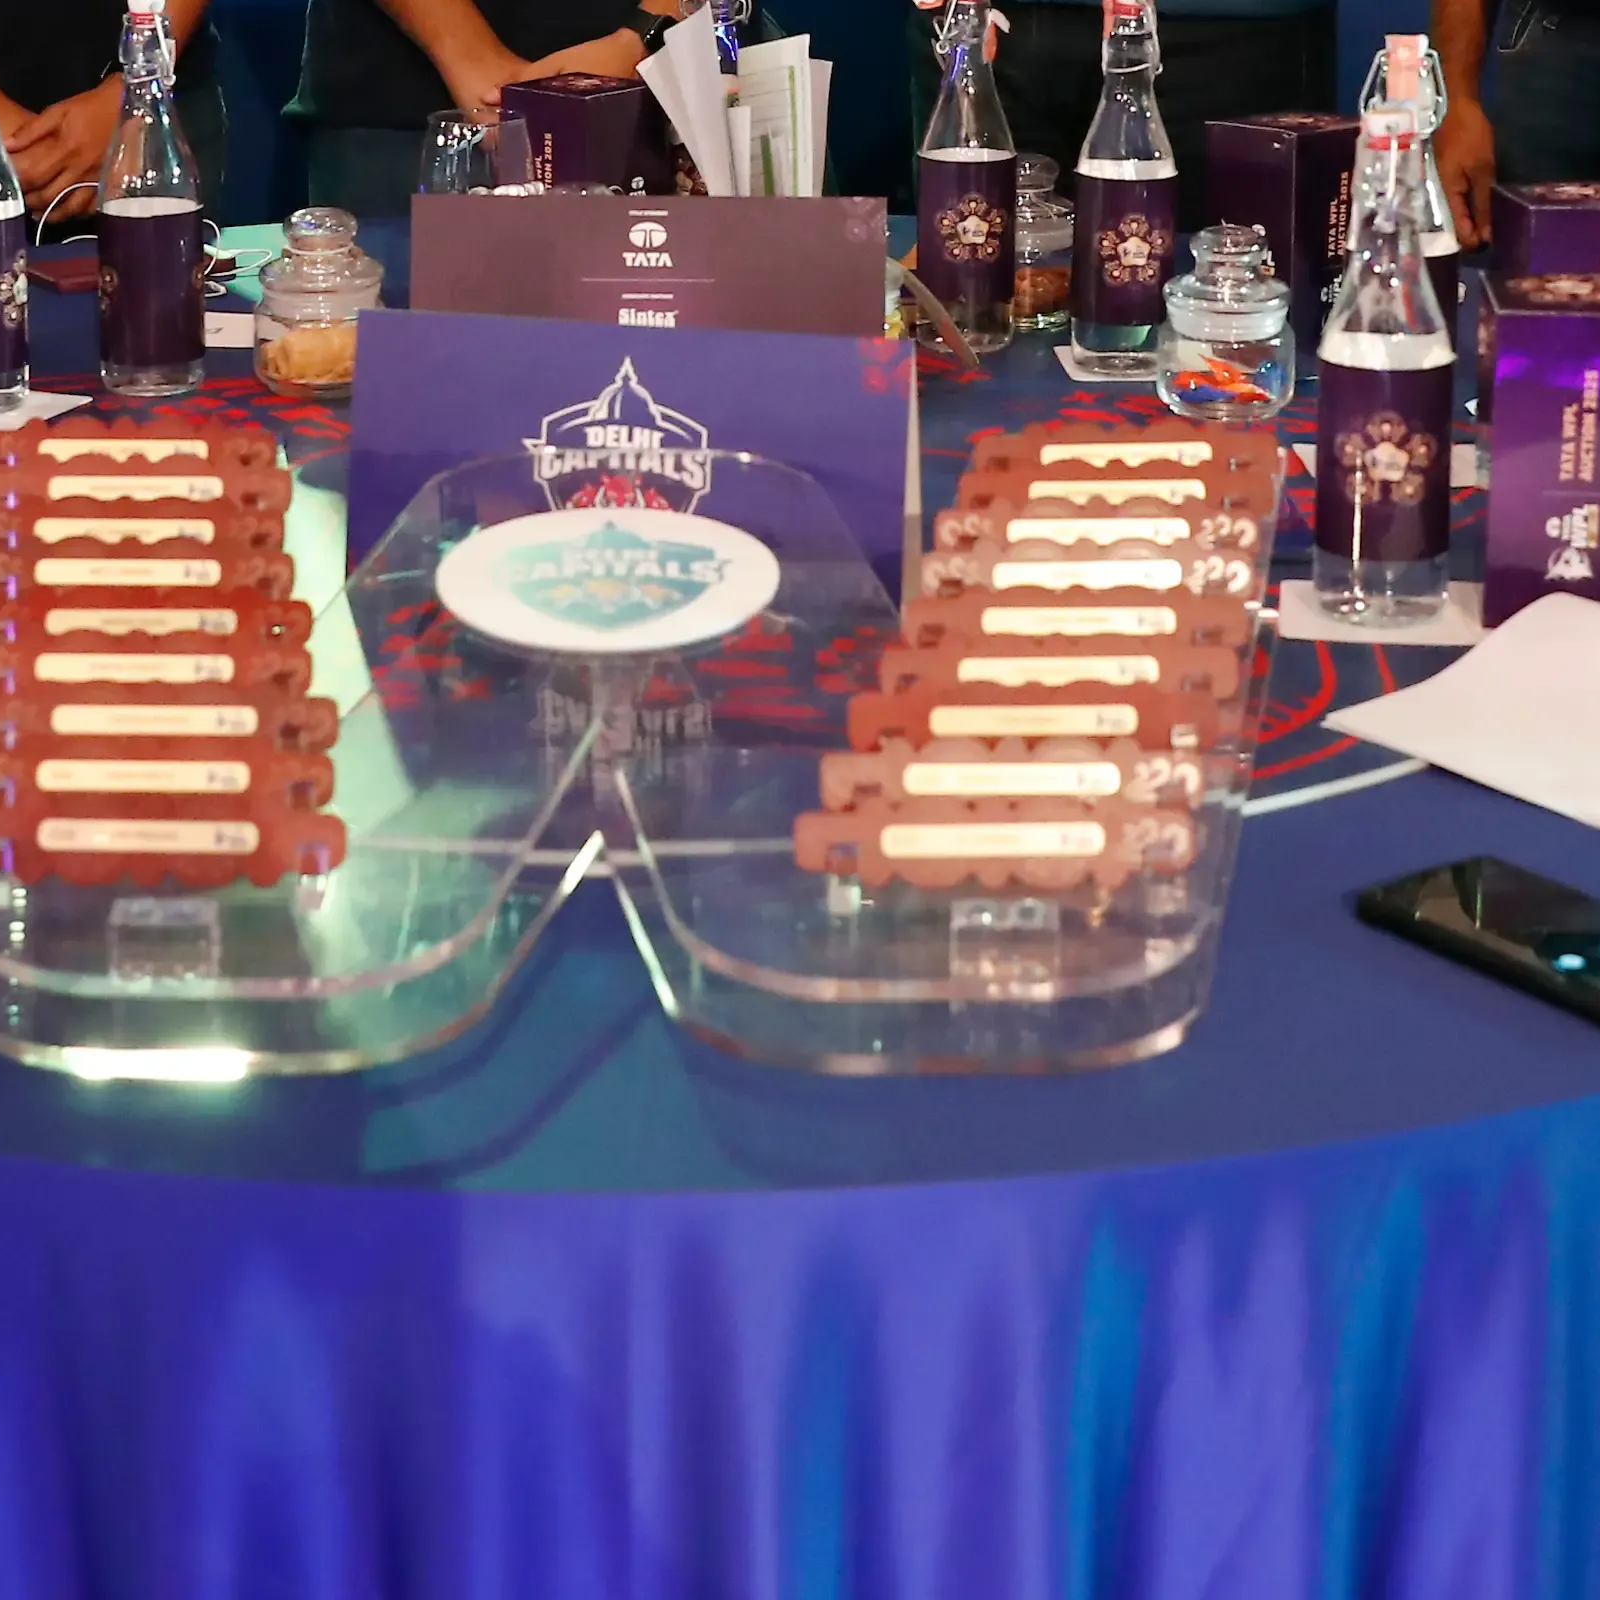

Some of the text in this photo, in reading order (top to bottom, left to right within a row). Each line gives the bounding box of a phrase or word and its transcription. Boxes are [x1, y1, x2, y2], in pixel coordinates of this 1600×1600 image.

[544, 132, 552, 160] 2025
[1328, 198, 1338, 258] TATA WPL
[1337, 171, 1349, 255] AUCTION 2025
[622, 252, 674, 267] TATA
[584, 424, 665, 449] DELHI
[1559, 403, 1578, 481] TATA WPL
[1578, 413, 1596, 483] AUCTION
[540, 448, 707, 489] CAPITALS
[1571, 504, 1589, 548] WPL
[504, 558, 725, 583] CAPITALS
